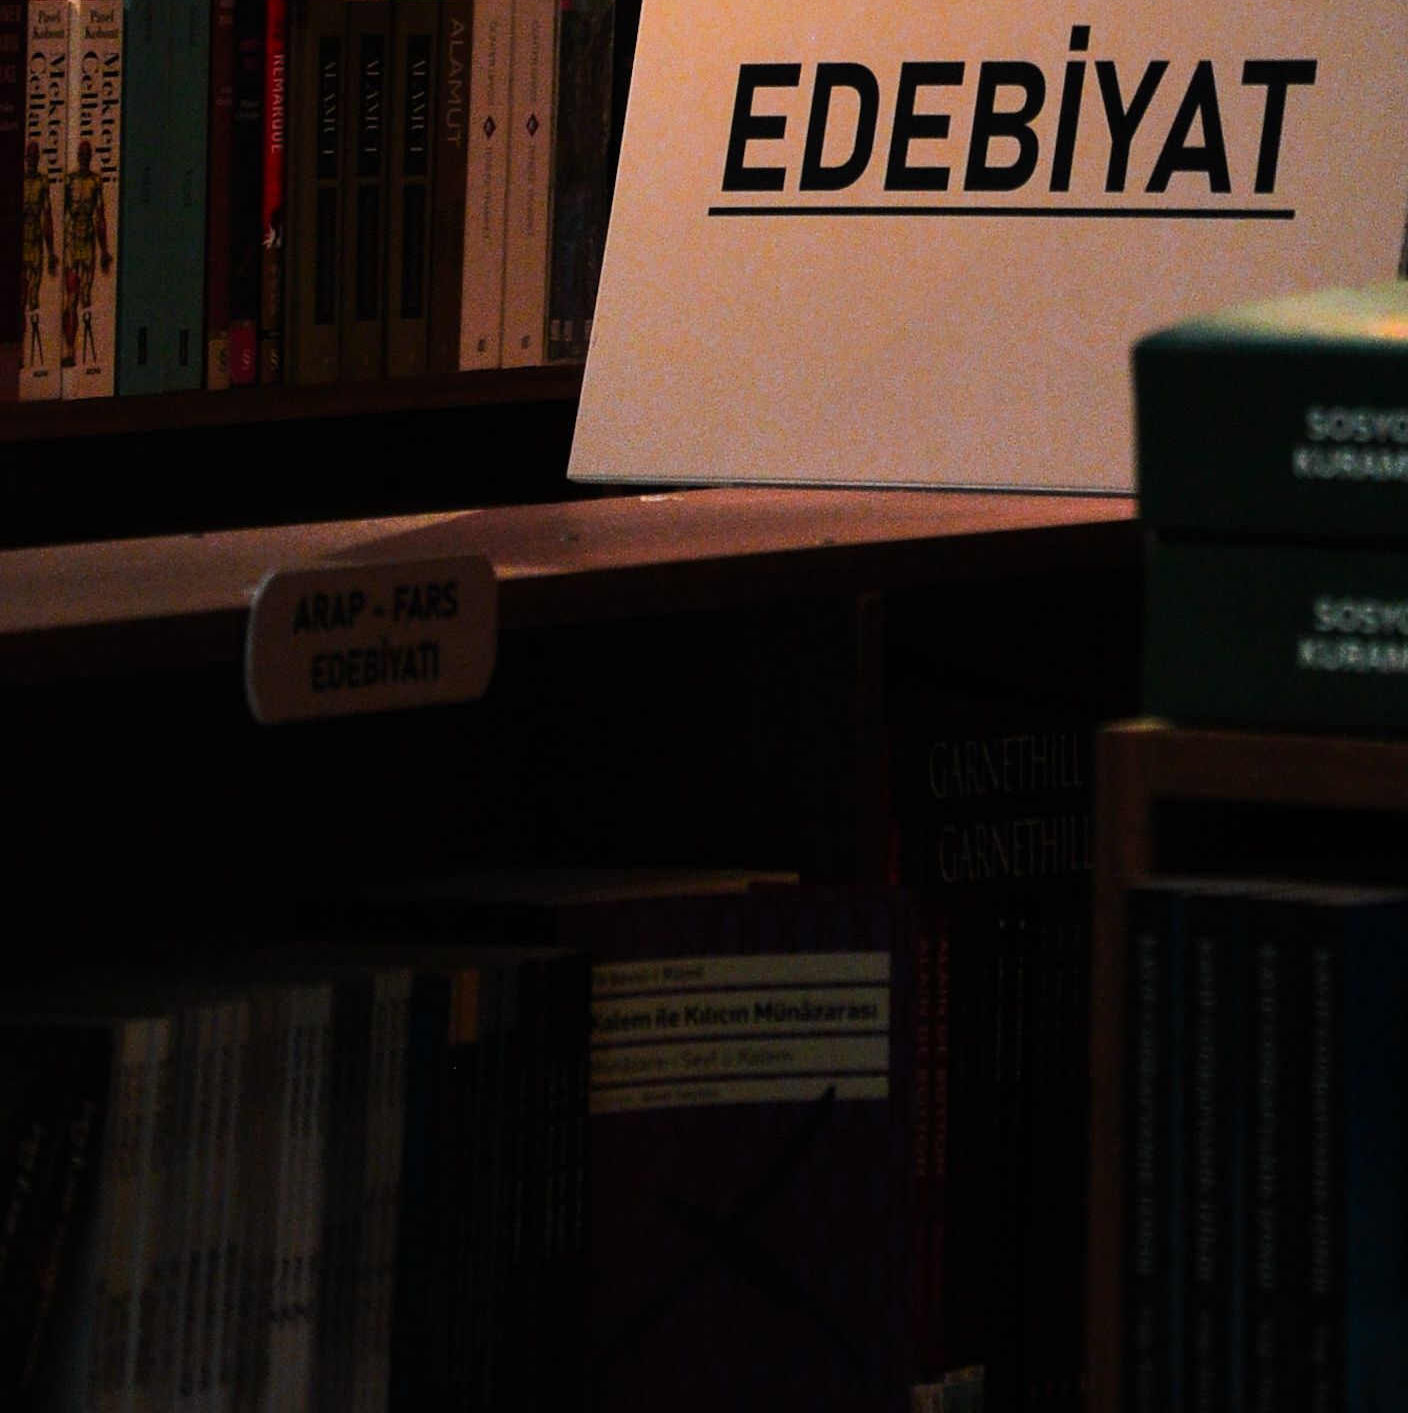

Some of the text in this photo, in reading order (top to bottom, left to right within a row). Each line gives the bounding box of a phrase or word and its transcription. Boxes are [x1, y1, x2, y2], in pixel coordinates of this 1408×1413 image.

[271, 54, 285, 155] REMARQUE
[446, 16, 465, 149] ALAMUT
[720, 25, 1317, 194] EDEBİYAT
[294, 591, 366, 633] ARAP
[393, 581, 459, 619] FARS
[311, 638, 441, 694] EDEBİYATI
[927, 730, 1084, 802] GARNETHILL
[656, 1009, 680, 1027] ile
[685, 1004, 750, 1026] Kılıcın
